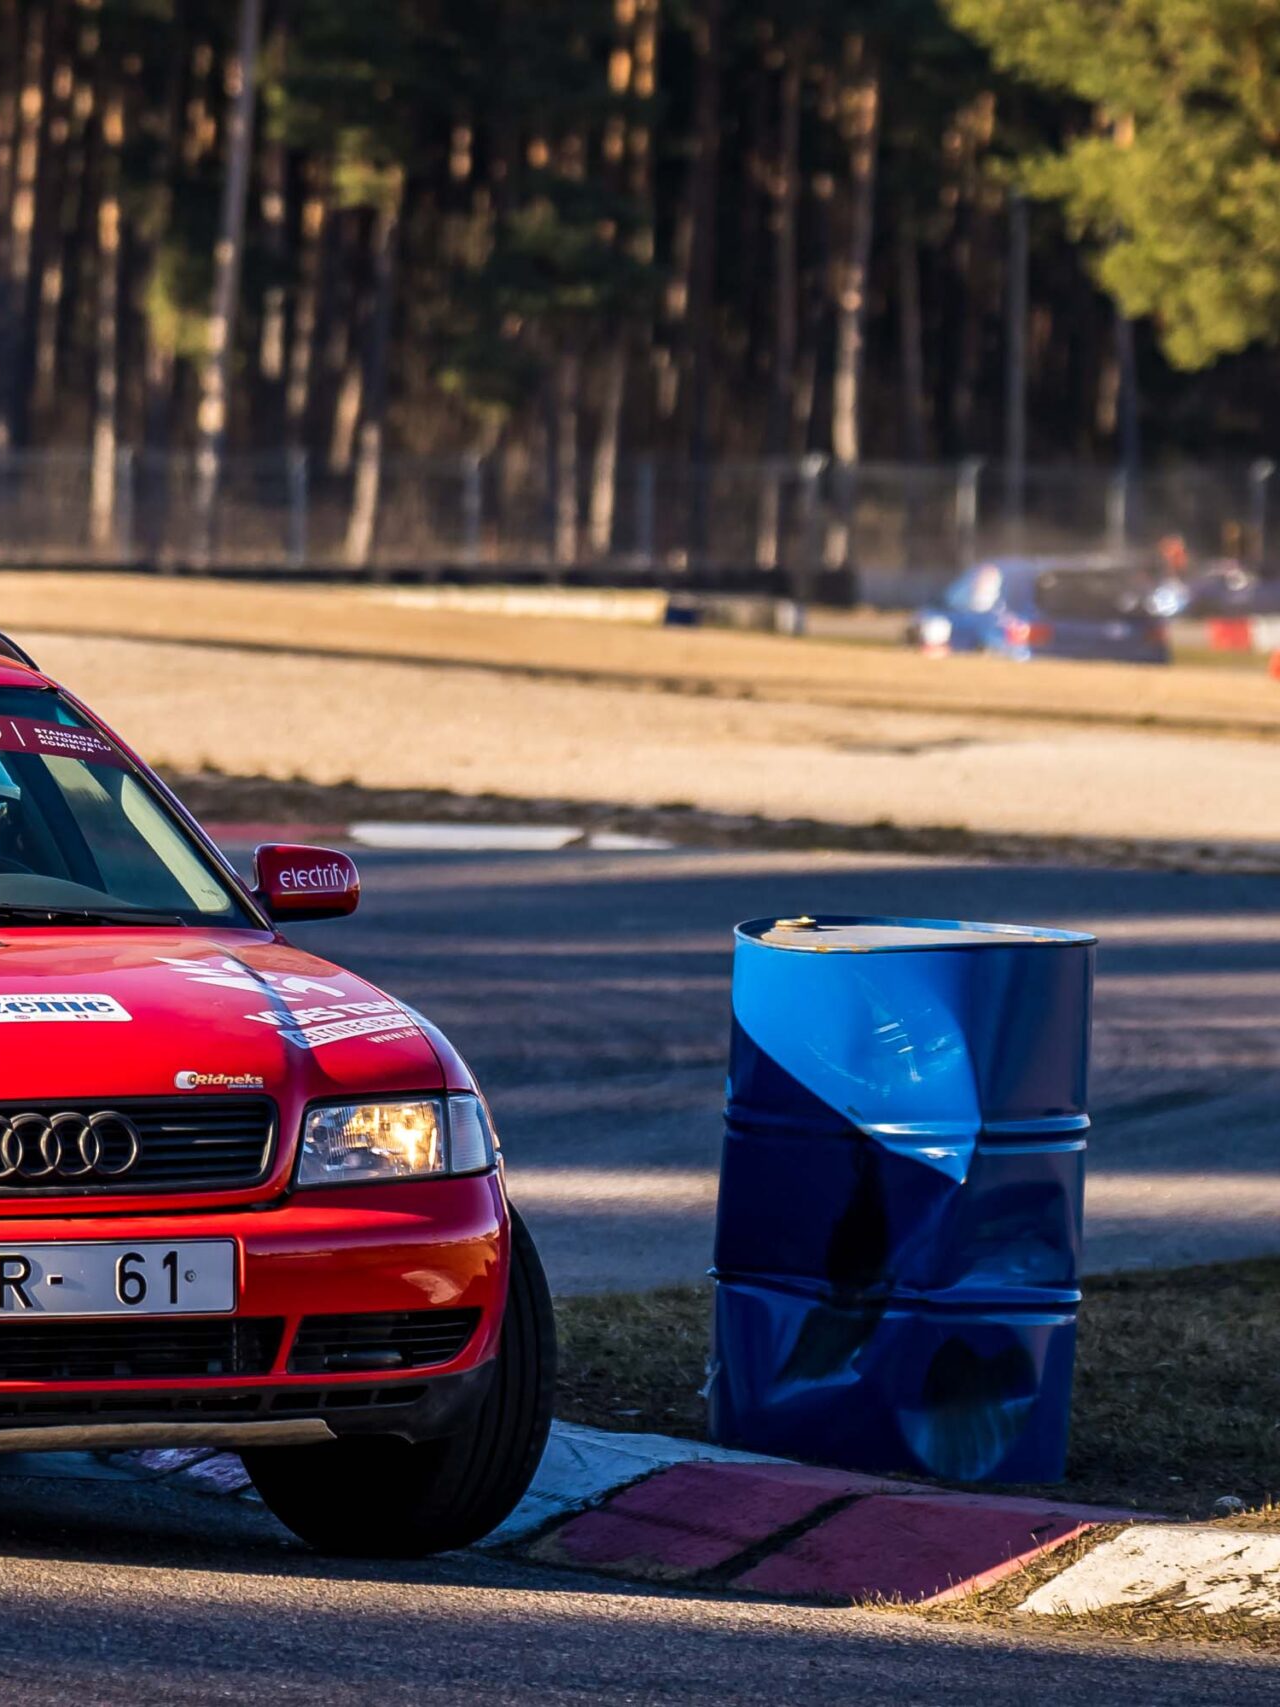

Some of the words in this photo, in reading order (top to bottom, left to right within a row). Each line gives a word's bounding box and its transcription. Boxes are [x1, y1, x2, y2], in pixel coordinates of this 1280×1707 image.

[33, 728, 102, 743] STANDARTA
[39, 740, 95, 753] KOMISIJA
[279, 863, 350, 892] electrify
[243, 1006, 347, 1026] VIDES
[195, 1073, 264, 1086] Ridneks
[116, 1250, 179, 1305] 61
